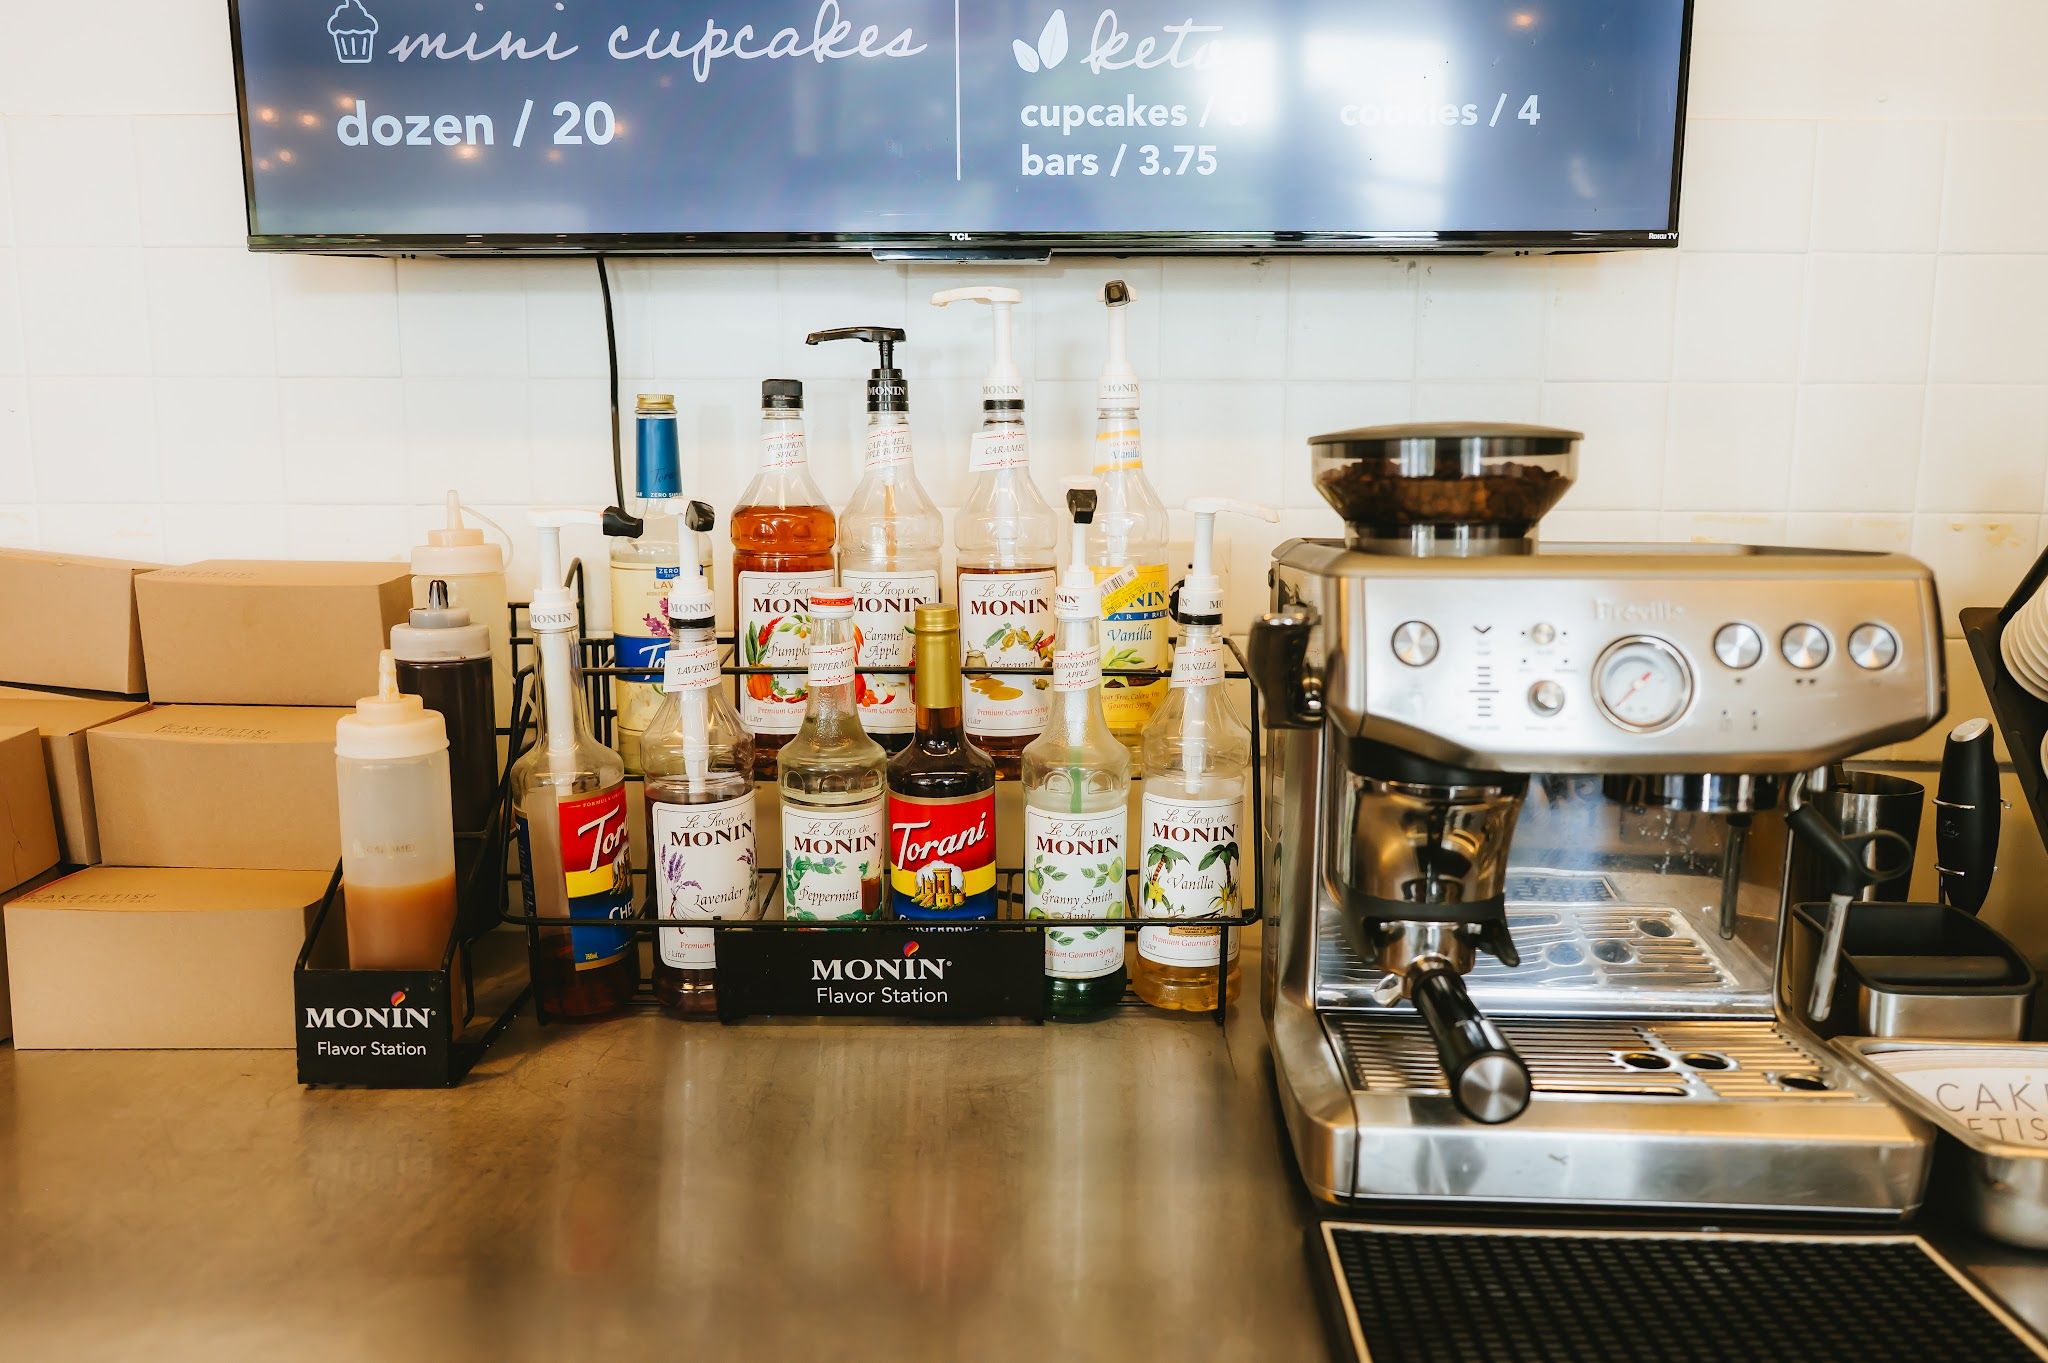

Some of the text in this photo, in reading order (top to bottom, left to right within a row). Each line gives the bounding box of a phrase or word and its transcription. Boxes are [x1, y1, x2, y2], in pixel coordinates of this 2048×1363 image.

[388, 0, 928, 82] mini cupcakes
[1021, 94, 1188, 136] cupcakes
[1489, 93, 1508, 127] /
[1517, 95, 1541, 126] 4
[337, 100, 616, 148] dozen / 20
[1021, 144, 1218, 177] bars / 3.75
[950, 233, 971, 241] TCL
[1648, 232, 1678, 240] Roku TV
[868, 386, 905, 396] MONIN
[776, 450, 799, 459] SPICE
[670, 602, 712, 613] MONIN
[753, 598, 809, 613] MON
[971, 597, 1049, 616] MONIN
[530, 612, 572, 624] MONIN
[864, 627, 905, 641] Caramel
[1107, 623, 1152, 642] Vanilla
[865, 642, 900, 659] Apple
[1065, 669, 1089, 679] APPLE
[1179, 661, 1217, 672] VANILLA
[671, 820, 753, 847] MONIN
[892, 811, 988, 871] Torani
[1152, 821, 1236, 843] MONIN
[794, 833, 878, 855] MONIN
[1036, 835, 1119, 856] MONIN
[1167, 873, 1214, 890] Vanilla
[694, 886, 744, 913] Lavender
[798, 885, 860, 906] Peppermint
[1041, 888, 1113, 909] Granny Smith
[680, 941, 711, 949] Premium
[816, 986, 948, 1004] Flavor Station
[317, 1041, 427, 1056] Flavor Station
[1936, 1083, 2048, 1112] CAK
